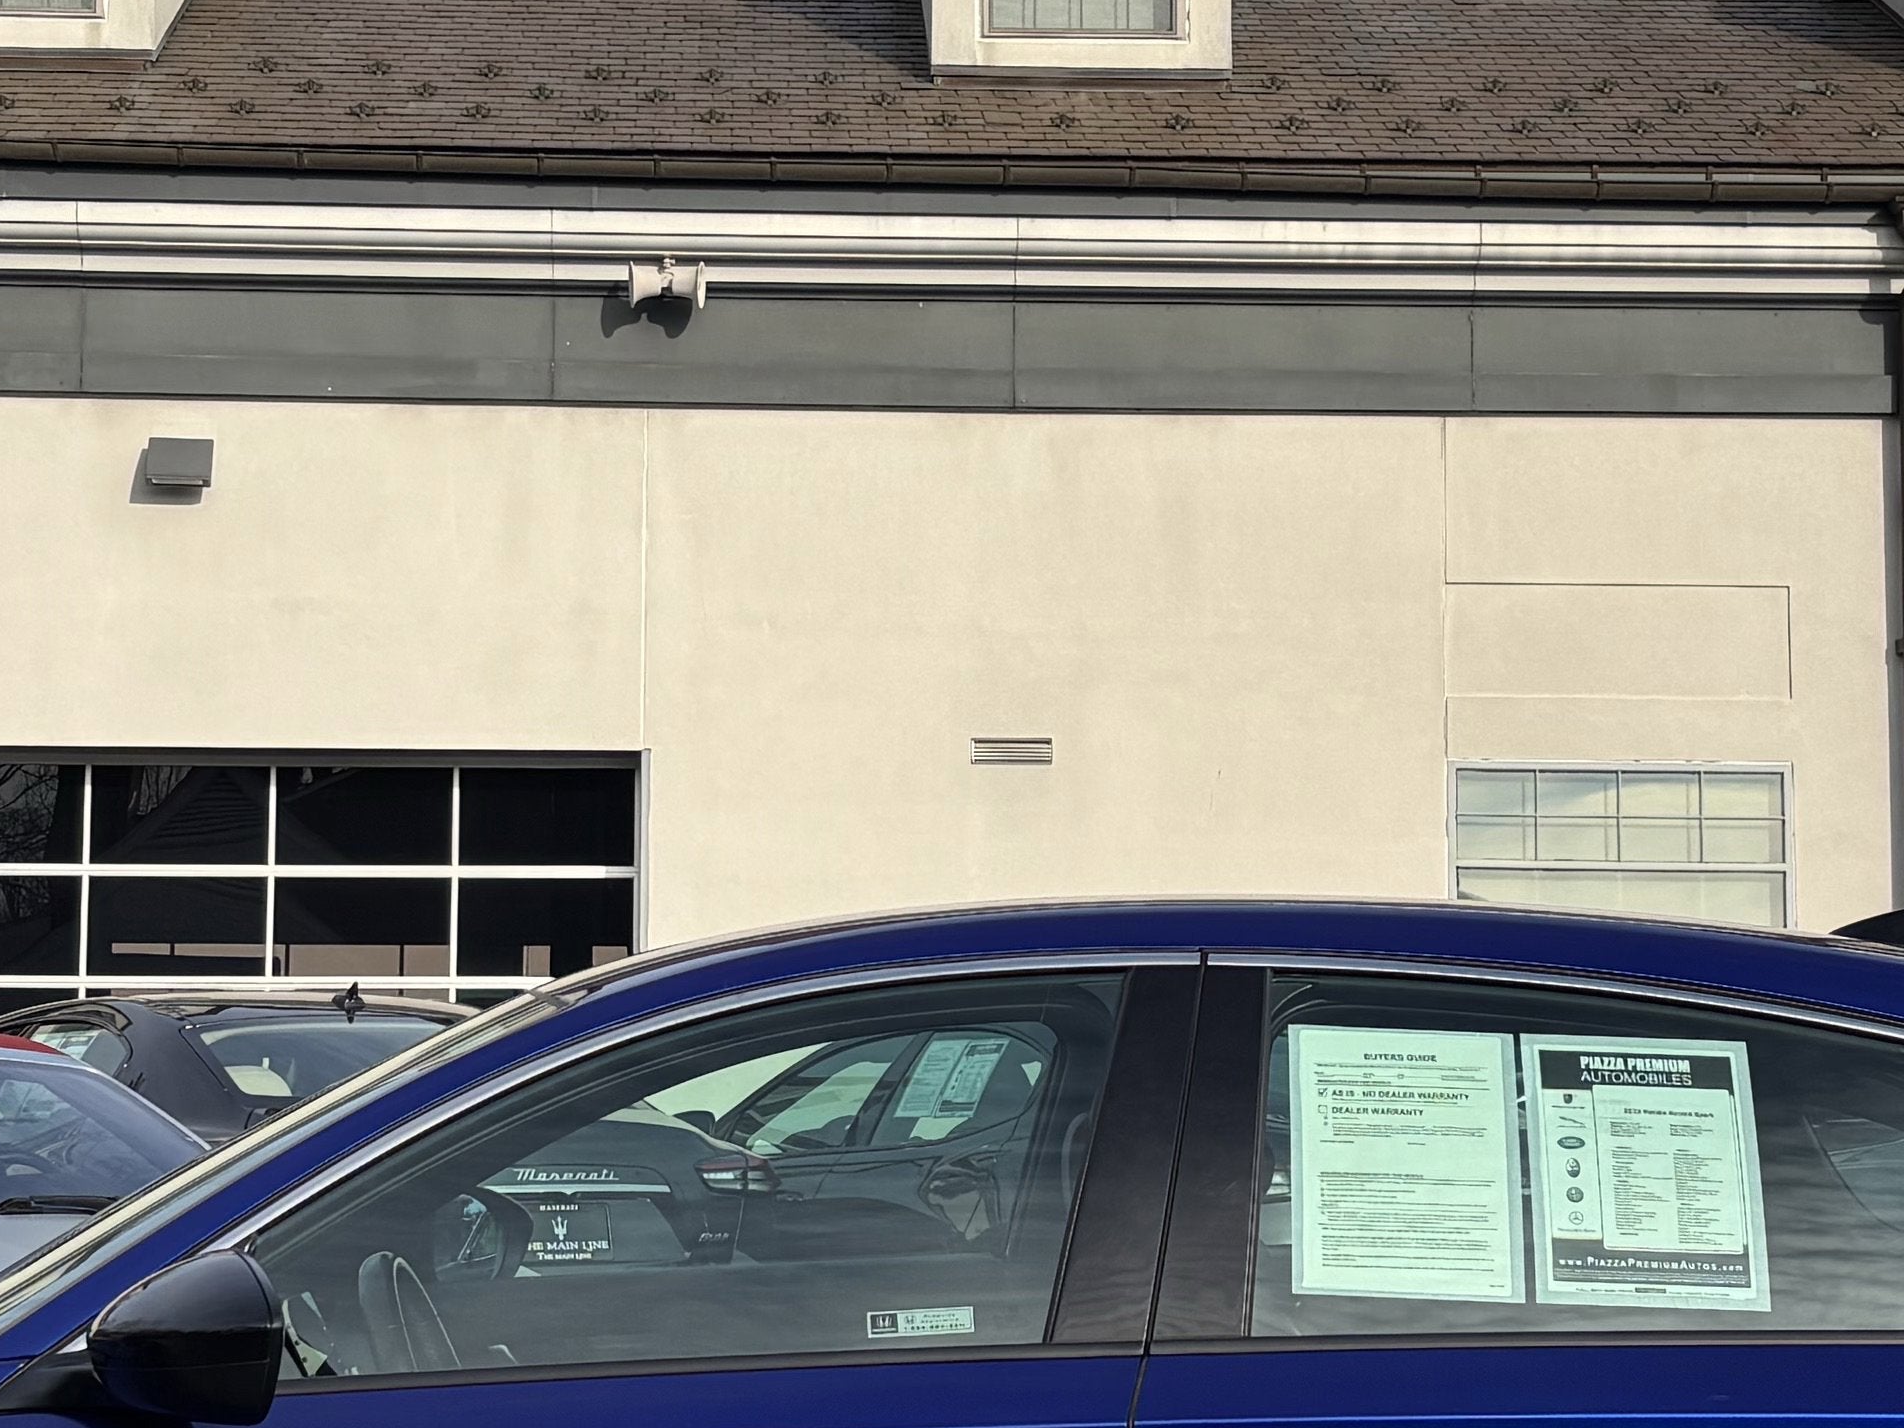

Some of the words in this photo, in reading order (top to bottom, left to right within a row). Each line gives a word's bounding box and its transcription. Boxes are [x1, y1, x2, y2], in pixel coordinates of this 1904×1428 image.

[1579, 1056, 1625, 1071] PIAZZA
[1627, 1057, 1691, 1073] PREMIUM
[1581, 1071, 1692, 1086] AUTOMOBILES
[1378, 1091, 1416, 1099] DEALER
[1417, 1092, 1470, 1101] WARRANTY
[1331, 1106, 1369, 1115] DEALER
[1371, 1107, 1424, 1116] WARRANTY
[513, 1168, 620, 1182] Maserati
[546, 1241, 578, 1250] MAIN
